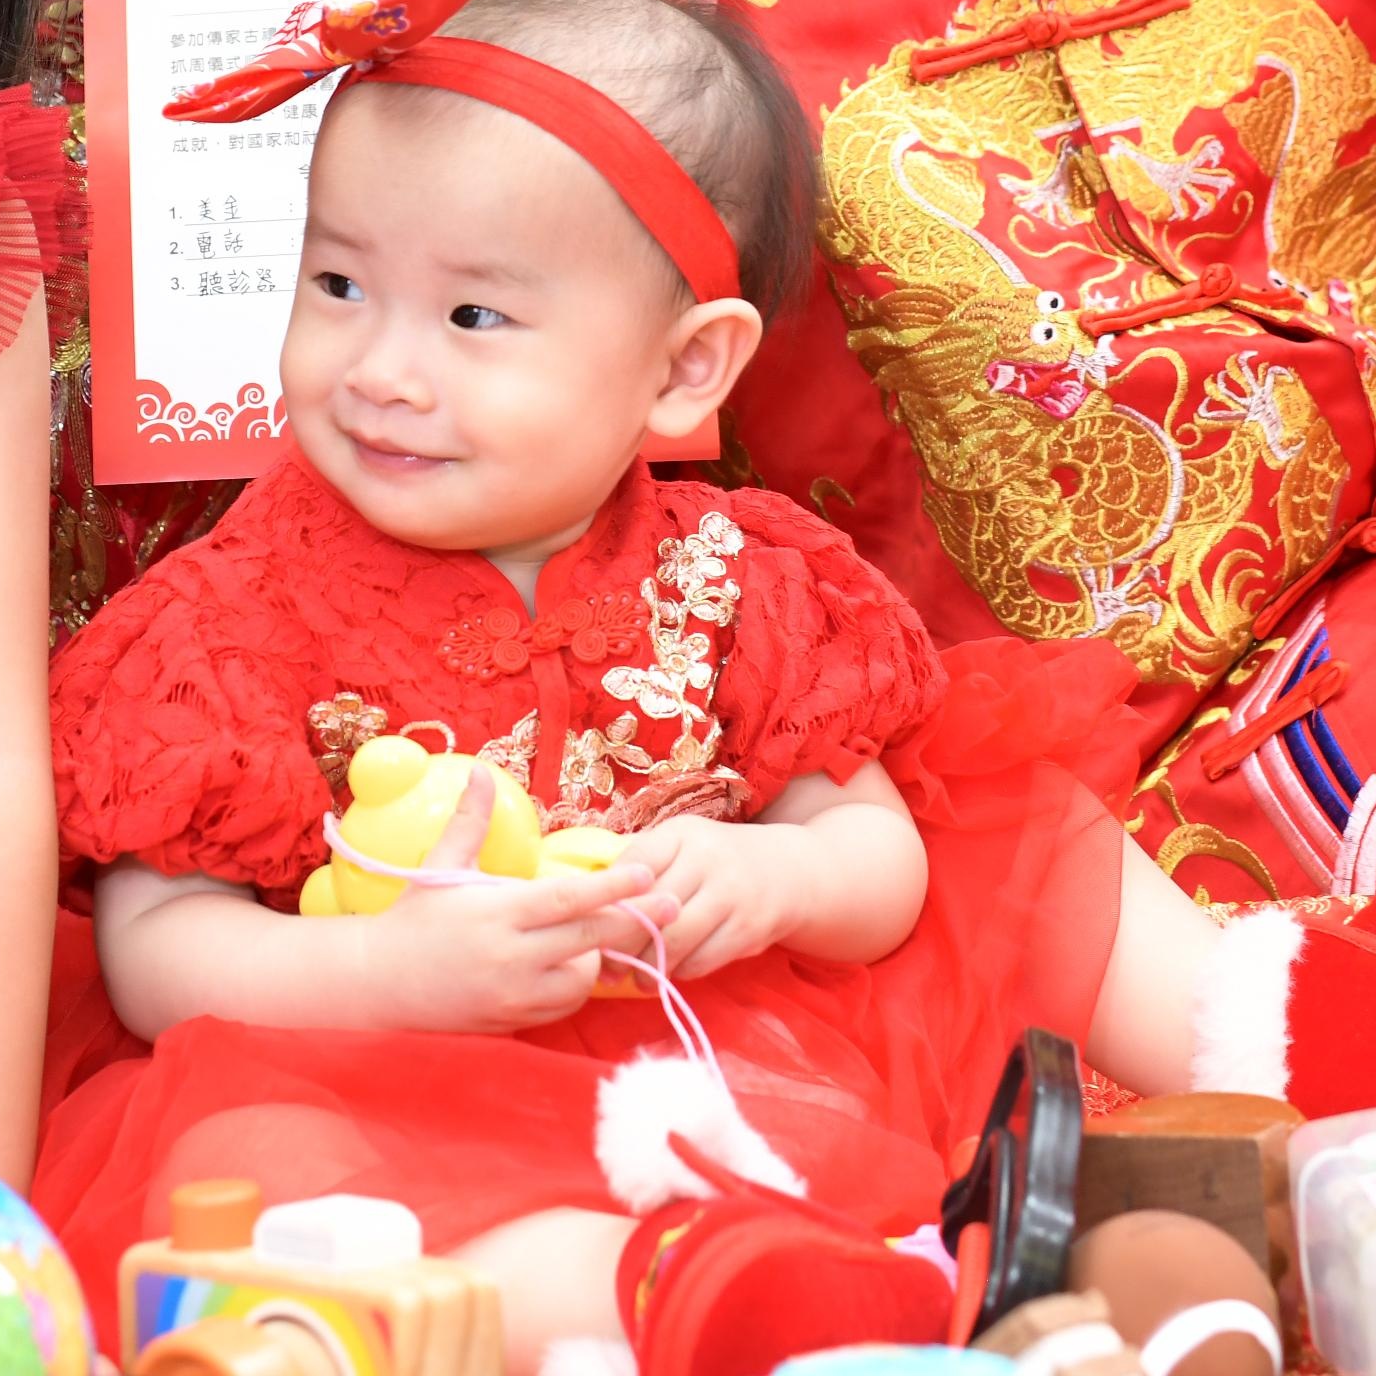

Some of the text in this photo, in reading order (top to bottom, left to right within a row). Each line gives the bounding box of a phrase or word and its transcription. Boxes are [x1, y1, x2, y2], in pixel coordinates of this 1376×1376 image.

[198, 194, 243, 222] 美金
[196, 228, 245, 260] 電話
[198, 267, 277, 297] 聽診器
